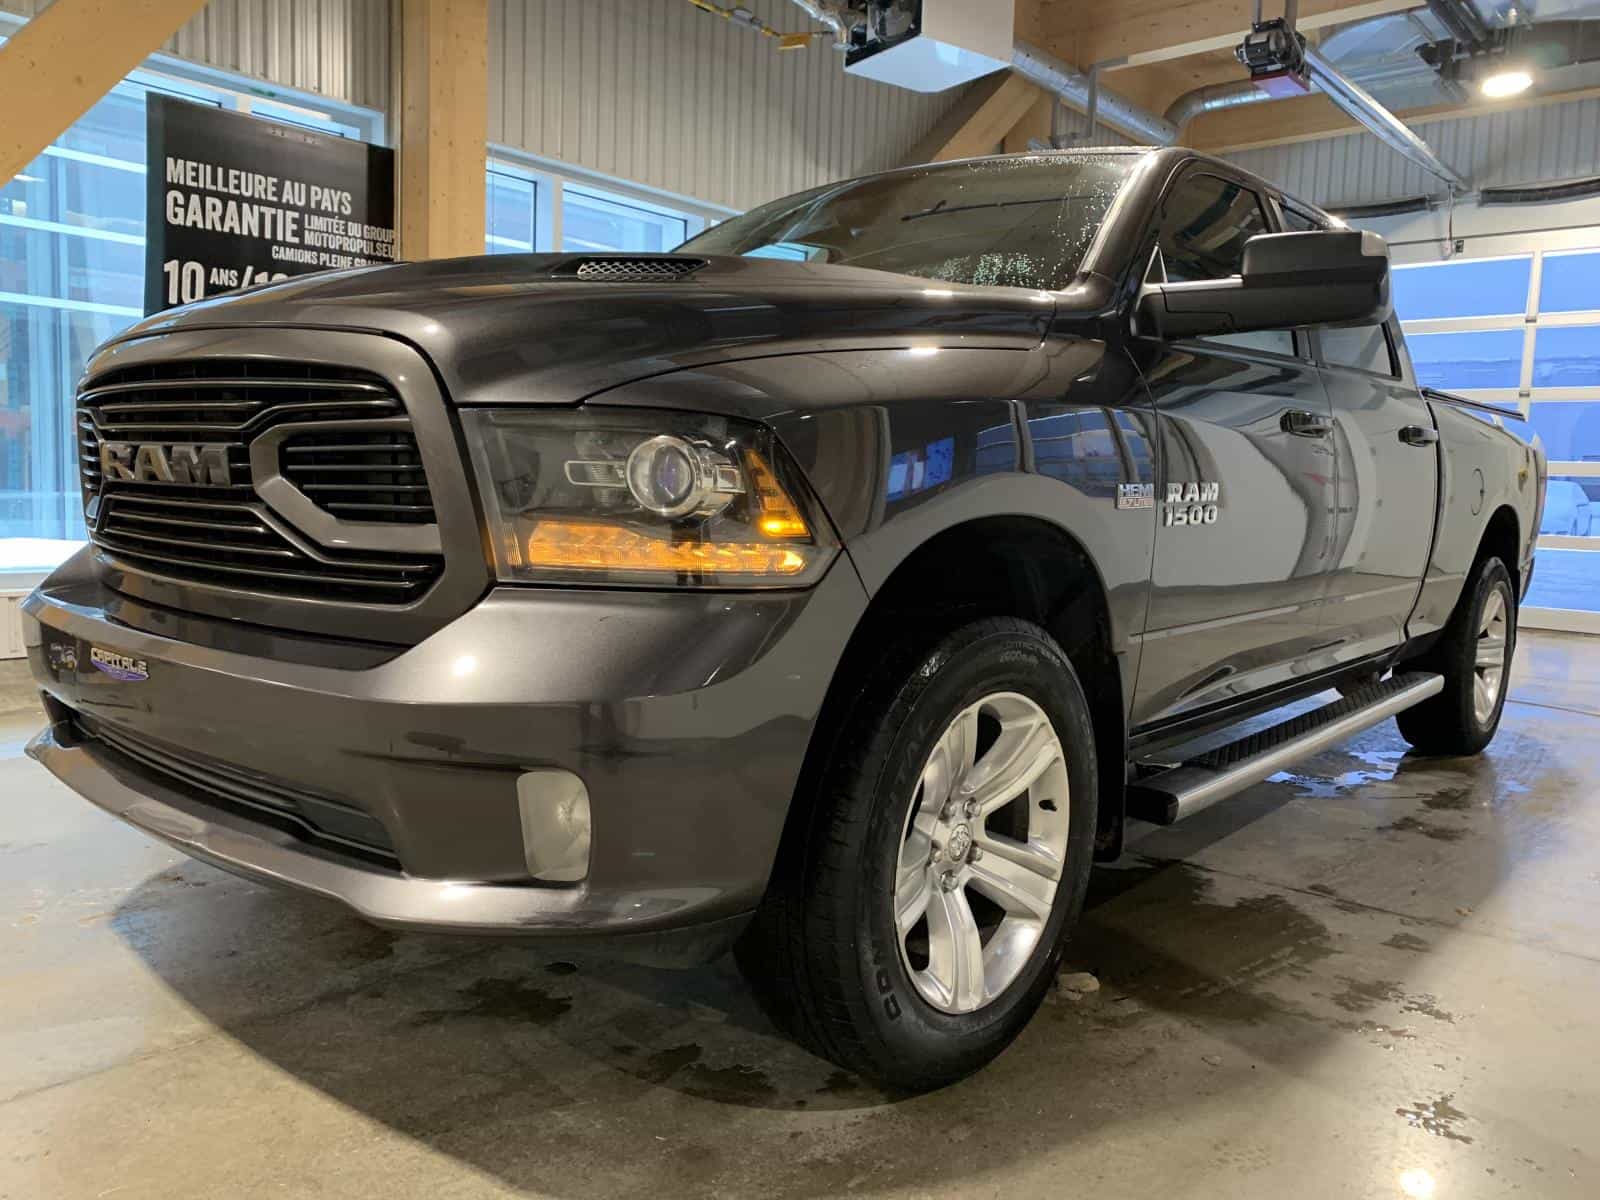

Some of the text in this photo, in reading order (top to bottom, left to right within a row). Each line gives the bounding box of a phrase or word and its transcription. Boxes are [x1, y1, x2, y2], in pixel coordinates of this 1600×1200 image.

[166, 157, 352, 215] MEILLEURE AU PAYS
[165, 189, 300, 244] GARANTIE
[304, 214, 346, 235] LIMITÉE
[347, 221, 362, 238] DU
[272, 245, 318, 265] CAMIONS
[163, 259, 205, 305] 10
[101, 443, 232, 488] RAM
[1165, 482, 1219, 503] RAM
[1164, 504, 1218, 527] 1500
[90, 647, 148, 675] CAPITALE
